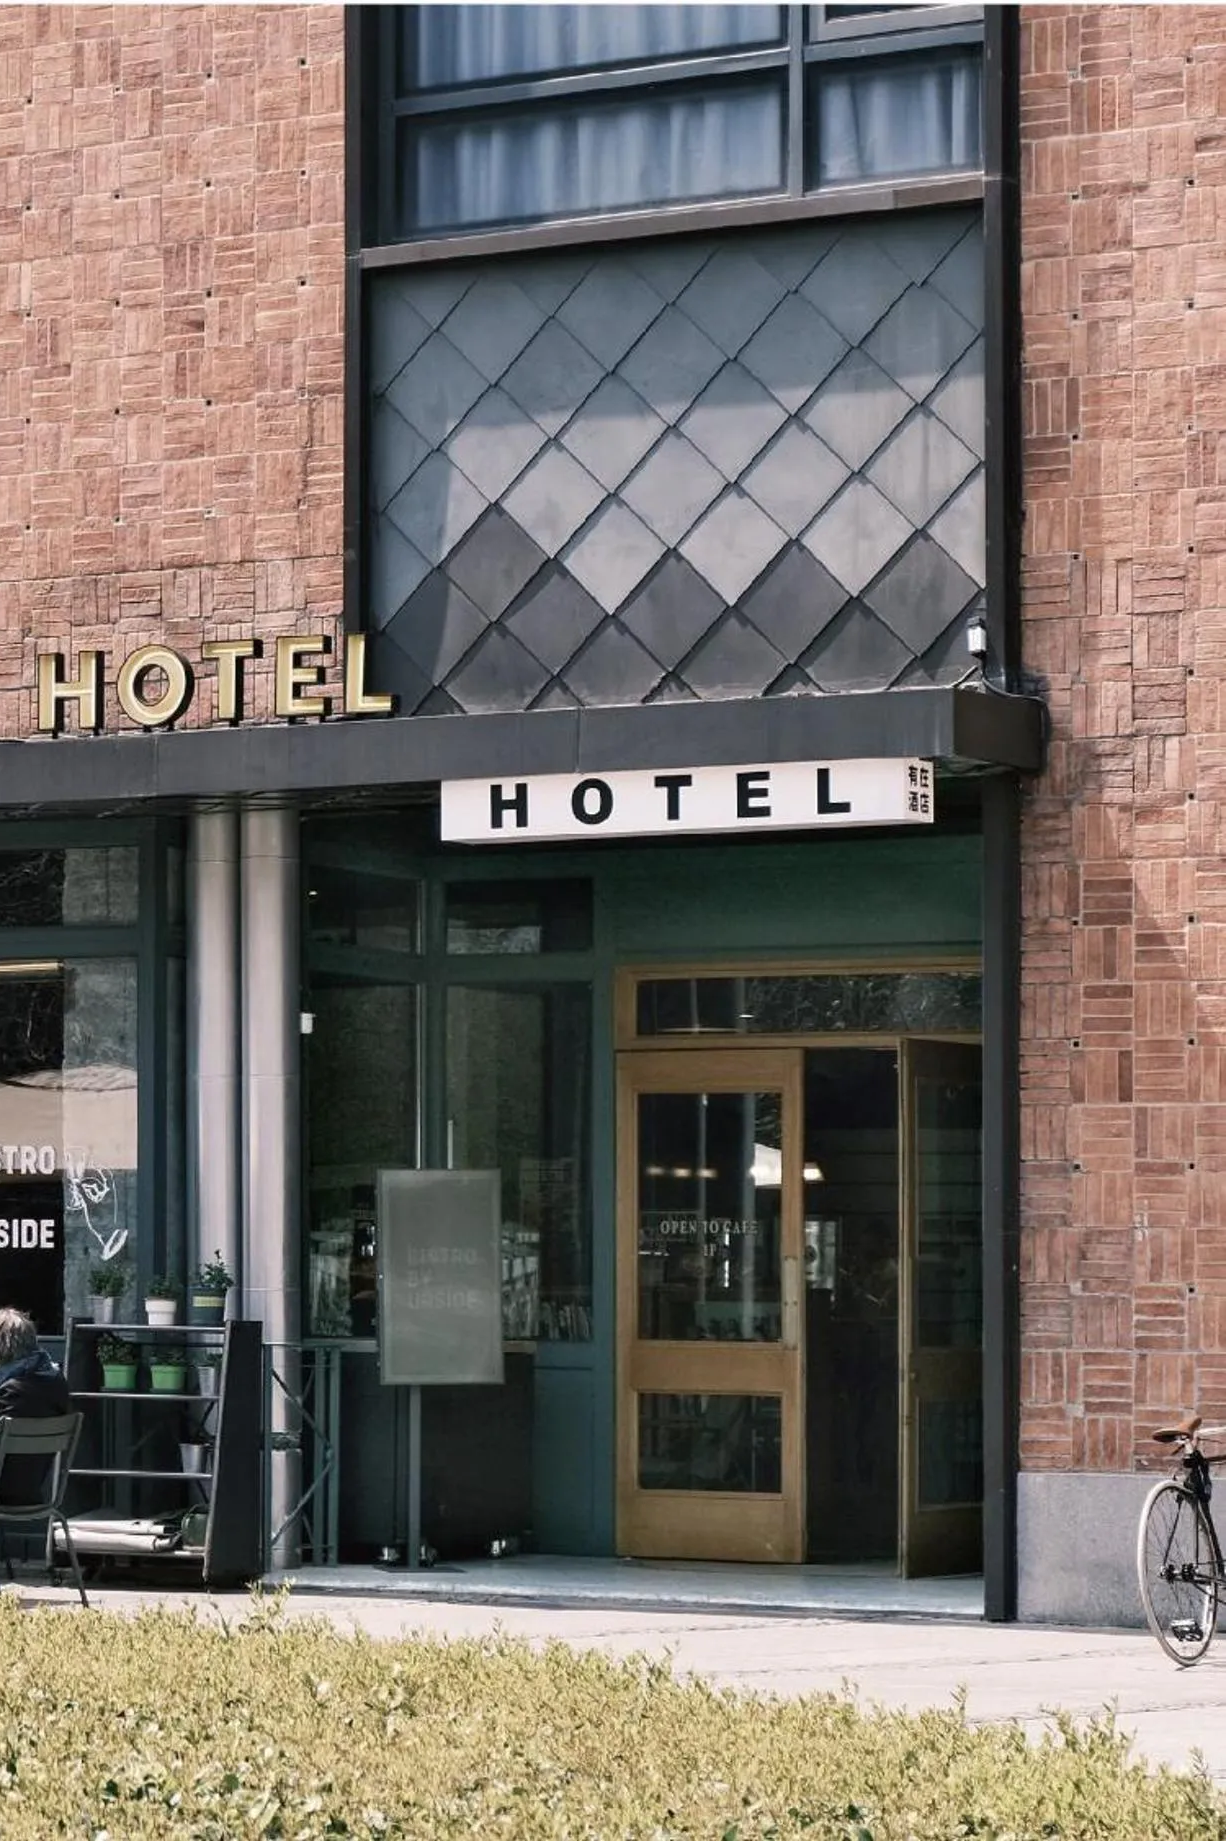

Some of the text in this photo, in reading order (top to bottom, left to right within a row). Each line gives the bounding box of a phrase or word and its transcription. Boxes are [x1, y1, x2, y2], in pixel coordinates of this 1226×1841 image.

[38, 633, 396, 733] HOTEL
[489, 767, 852, 829] HOTEL
[660, 1220, 698, 1234] OPEN
[702, 1220, 719, 1234] TO
